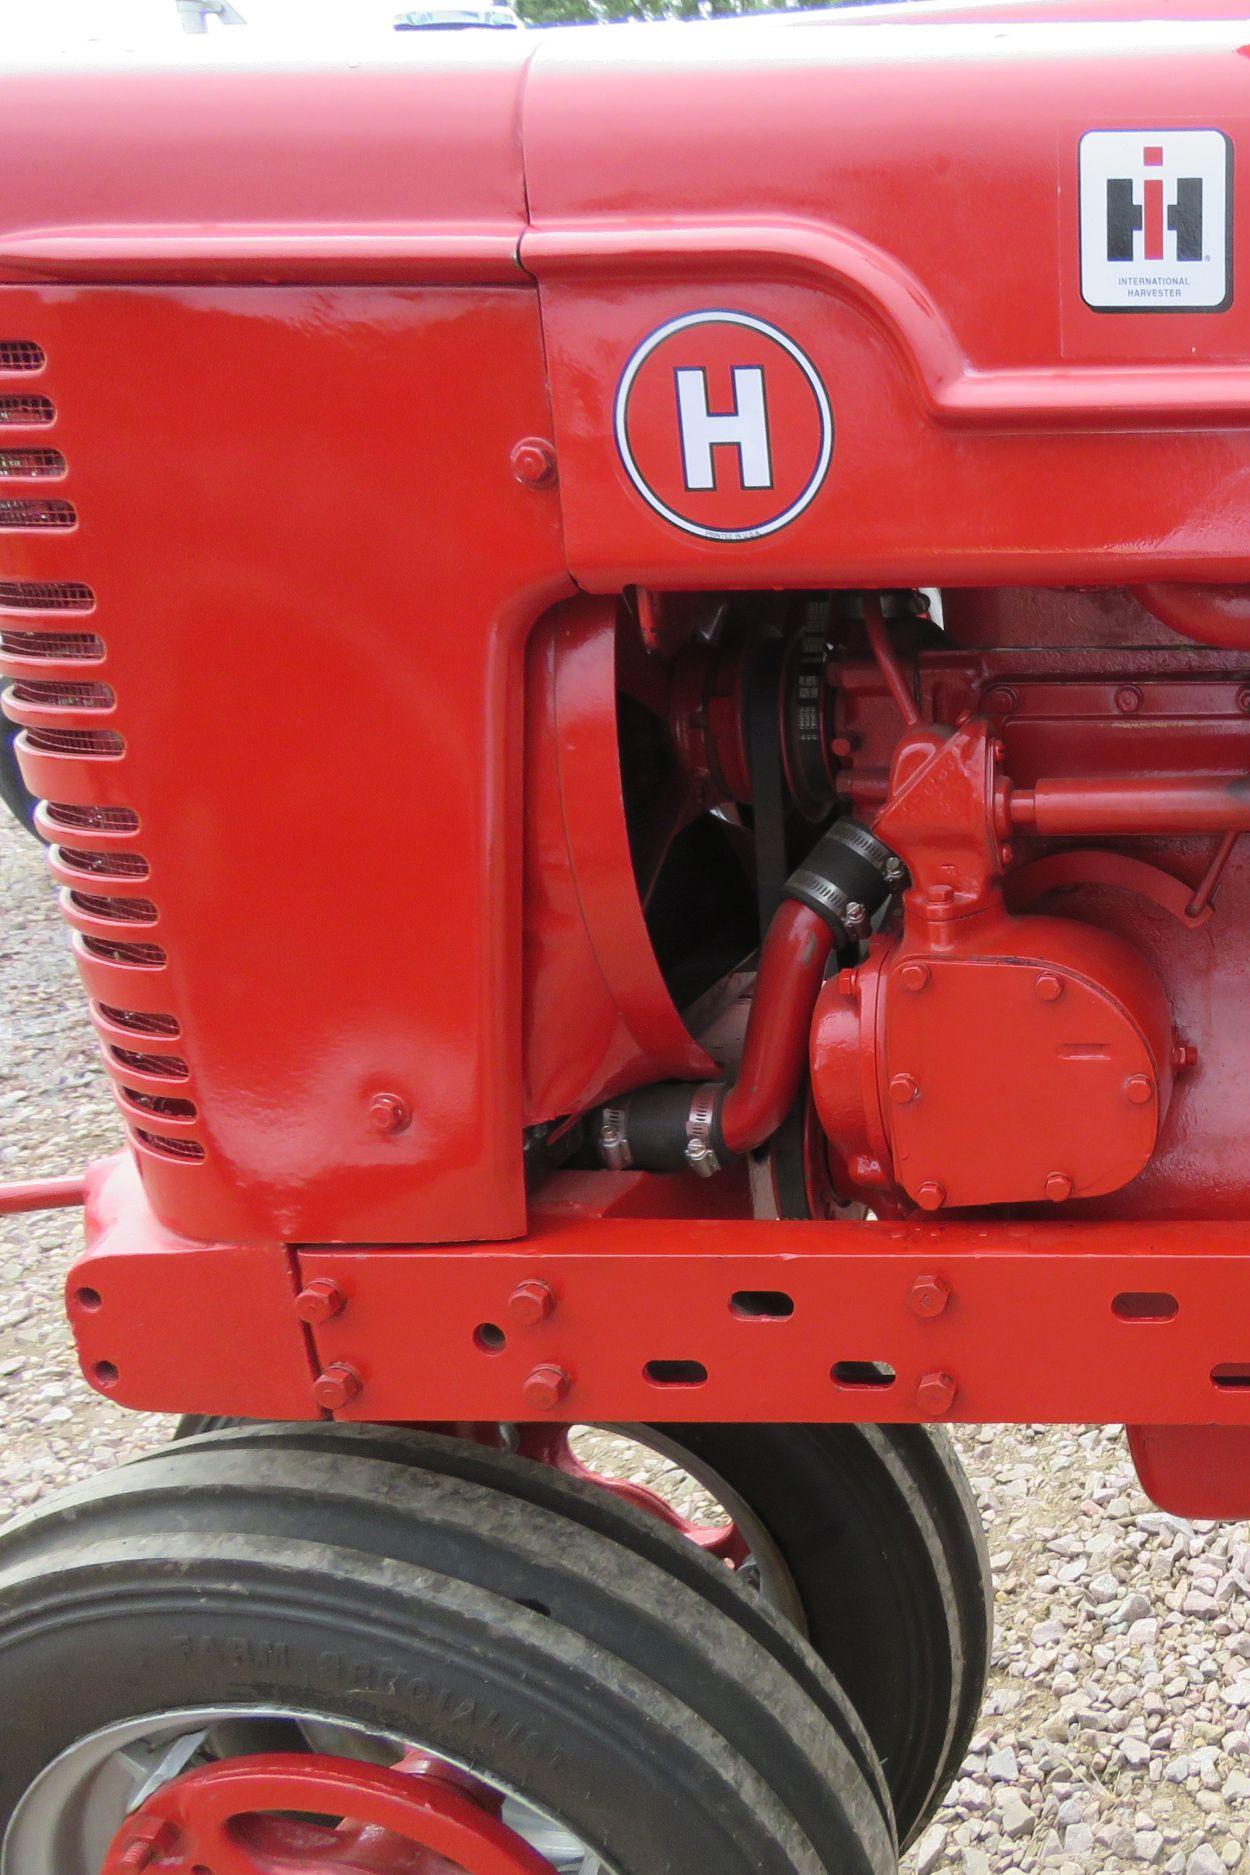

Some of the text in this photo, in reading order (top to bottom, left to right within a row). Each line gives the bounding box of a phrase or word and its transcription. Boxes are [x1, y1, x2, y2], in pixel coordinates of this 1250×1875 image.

[1118, 277, 1190, 286] INTERNATIONAL
[1127, 288, 1181, 297] HARVESTER
[674, 365, 774, 491] H
